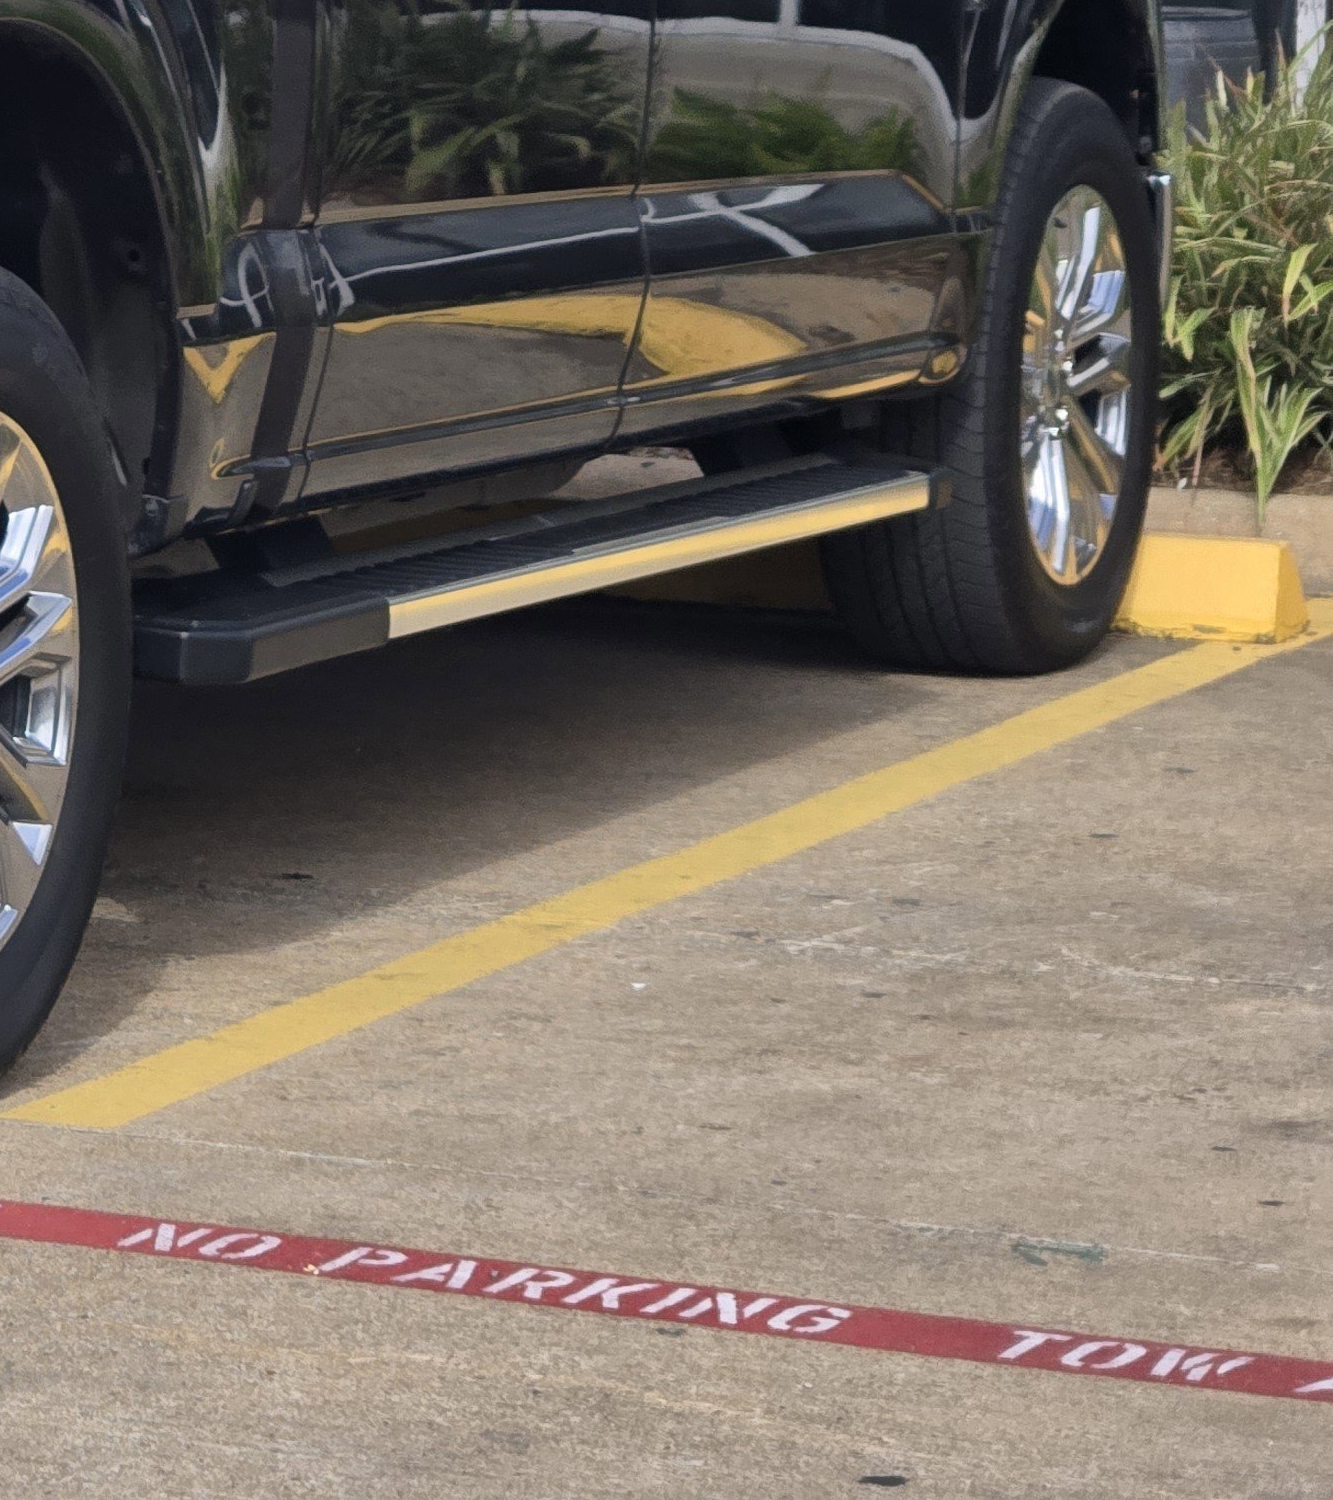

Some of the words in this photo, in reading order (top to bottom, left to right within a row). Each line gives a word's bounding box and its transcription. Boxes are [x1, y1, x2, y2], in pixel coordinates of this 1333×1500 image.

[116, 1222, 283, 1260] NO
[319, 1246, 852, 1334] PARKING
[997, 1329, 1255, 1382] TOW
